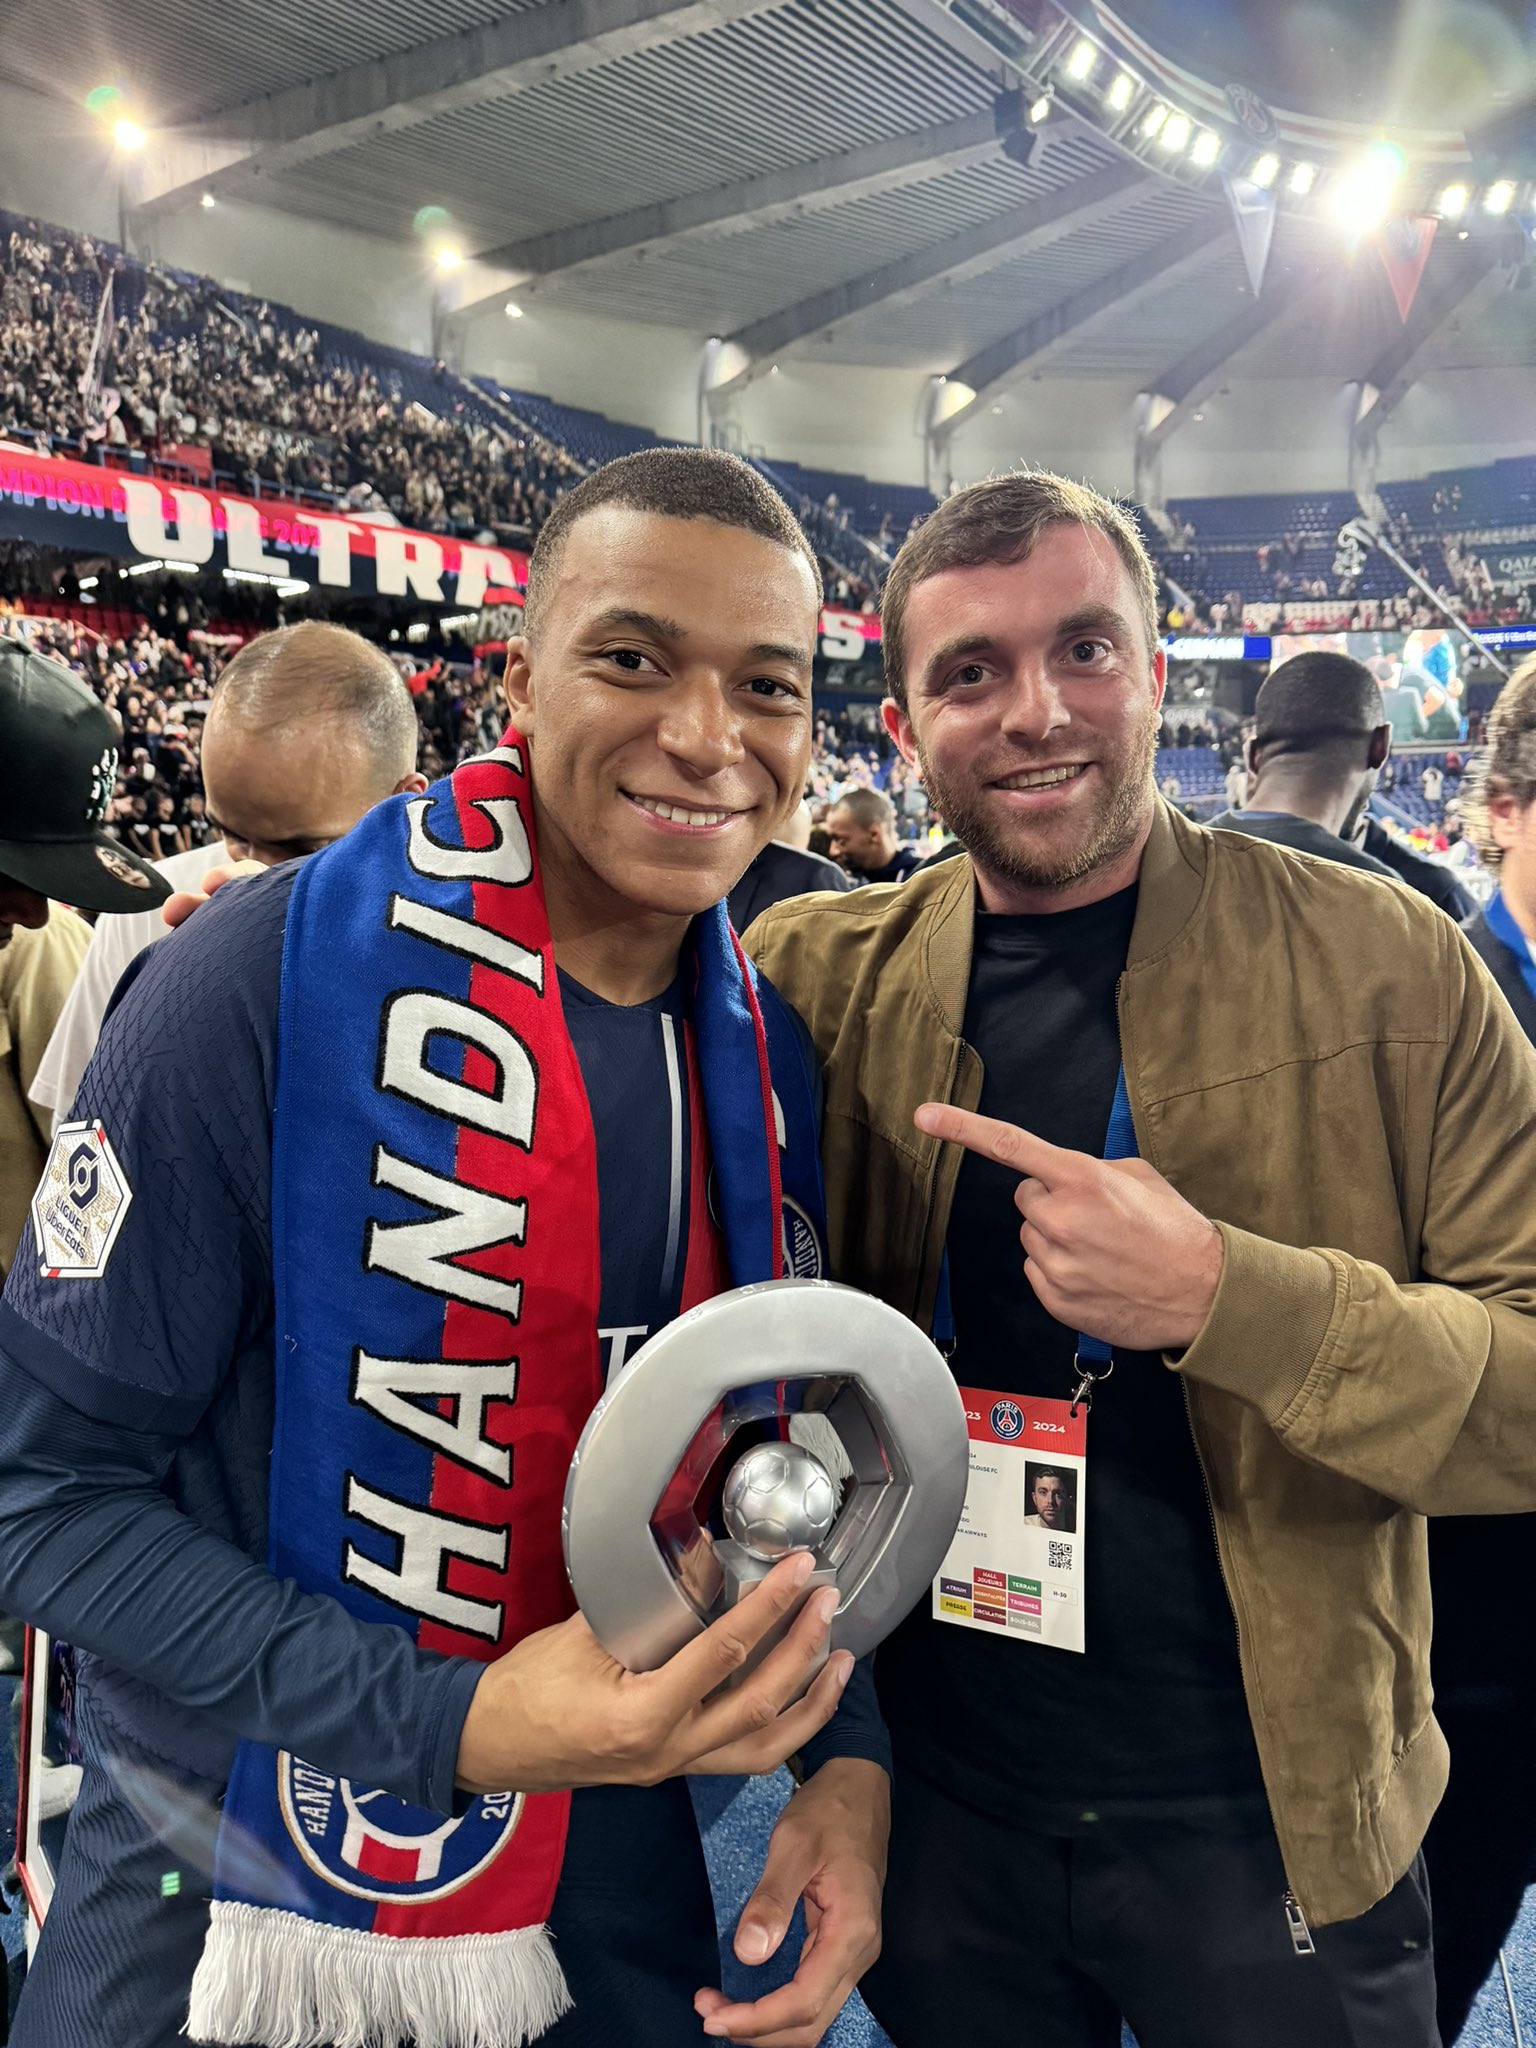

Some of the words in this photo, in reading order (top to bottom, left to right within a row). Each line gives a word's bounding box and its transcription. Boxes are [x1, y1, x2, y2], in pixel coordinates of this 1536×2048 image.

[342, 744, 544, 1645] HANDIC
[793, 1219, 818, 1278] HANDIC
[996, 1402, 1018, 1413] PARIS
[1033, 1421, 1066, 1433] 2024
[982, 1571, 998, 1580] HALL
[977, 1576, 1003, 1587] JOUEURS
[1012, 1581, 1038, 1592] TERRAIN
[946, 1584, 967, 1594] ATRIUM
[945, 1601, 967, 1611] PRESSE
[1010, 1598, 1039, 1611] TRIBUNES
[974, 1607, 1006, 1620] CIRCULATION
[1010, 1616, 1039, 1629] SOUS-SOL
